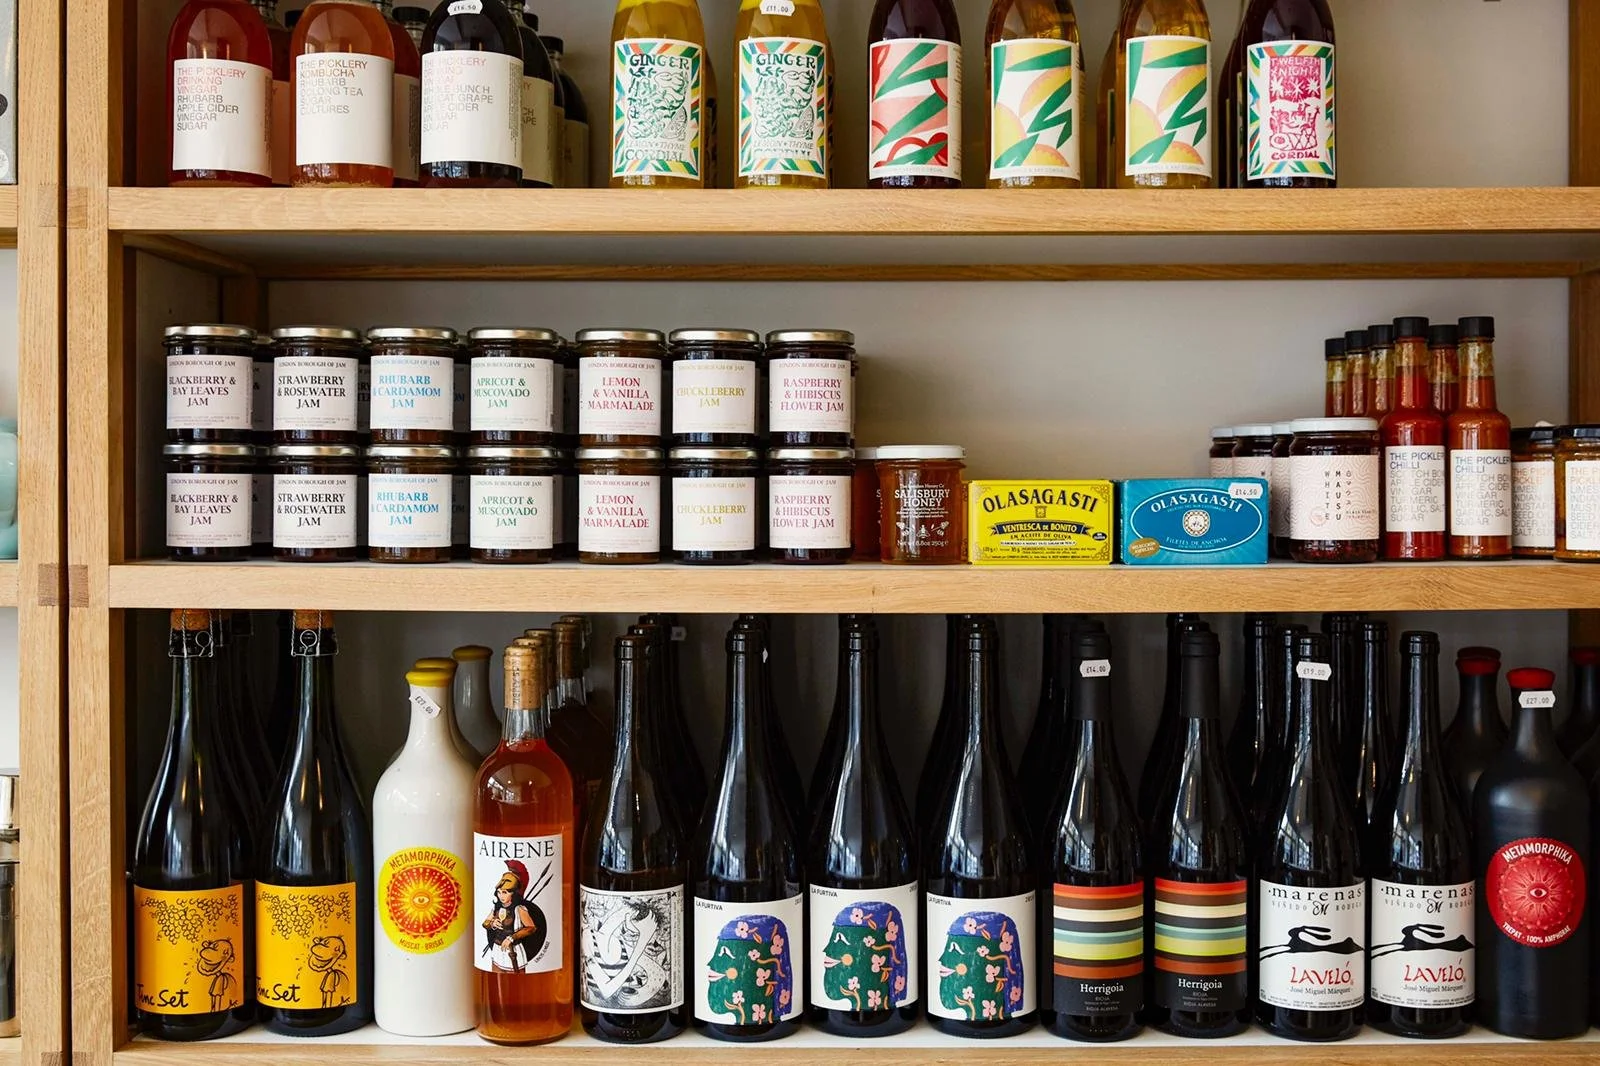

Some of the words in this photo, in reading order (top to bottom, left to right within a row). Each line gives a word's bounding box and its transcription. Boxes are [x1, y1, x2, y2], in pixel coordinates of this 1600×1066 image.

[300, 60, 317, 69] THE
[319, 60, 367, 69] PICKLERY
[629, 54, 689, 70] GINGER
[757, 54, 816, 69] GINGER
[1271, 57, 1320, 65] TWELFTH
[177, 67, 194, 76] THE
[197, 67, 246, 78] PICKLERY
[300, 69, 355, 78] KOMBUCHA
[177, 77, 222, 85] DRINKING
[177, 86, 217, 94] VINEGAR
[343, 87, 363, 96] TEA
[177, 95, 223, 103] RHUBARB
[458, 94, 493, 104] GRAPE
[177, 104, 204, 112] APPLE
[207, 104, 239, 114] CIDER
[177, 113, 217, 121] VINEGAR
[177, 122, 207, 131] SUGAR
[1271, 150, 1320, 160] CORDIAL
[169, 376, 227, 385] BLACKBERRY
[229, 377, 236, 385] &
[278, 375, 345, 385] STRAWBERRY
[379, 375, 431, 385] RHUBARB
[477, 377, 516, 386] APRICOT
[518, 378, 526, 386] &
[602, 377, 641, 387] LEMON
[783, 378, 842, 388] RASPBERRY
[173, 387, 187, 395] BAY
[191, 387, 229, 395] LEAVES
[277, 388, 282, 396] &
[284, 387, 346, 397] ROSEWATER
[378, 387, 441, 397] CARDAMOM
[474, 388, 530, 398] MUSCOVADO
[592, 389, 600, 398] &
[603, 389, 649, 399] VANILLA
[784, 391, 791, 399] &
[795, 390, 841, 400] HIBISCUS
[187, 398, 208, 407] JAM
[296, 399, 320, 409] JAM
[392, 399, 414, 408] JAM
[488, 399, 508, 408] JAM
[588, 401, 654, 411] MARMALADE
[699, 398, 720, 408] JAM
[780, 402, 823, 411] FLOWER
[825, 402, 844, 412] JAM
[1390, 452, 1407, 460] THE
[1390, 461, 1420, 469] CHILLI
[1455, 465, 1484, 473] CHILLI
[278, 493, 345, 502] STRAWBERRY
[377, 492, 429, 501] RHUBARB
[895, 489, 950, 498] SALISBURY
[231, 495, 238, 503] &
[481, 496, 525, 505] APRICOT
[526, 496, 535, 505] &
[595, 495, 634, 505] LEMON
[774, 495, 832, 505] RASPBERRY
[904, 498, 942, 507] HONEY
[982, 488, 1098, 513] OLASAGASTI
[1150, 493, 1244, 513] OLASAGASTI
[175, 505, 190, 514] BAY
[194, 505, 232, 514] LEAVES
[277, 505, 282, 514] &
[284, 505, 346, 514] ROSEWATER
[377, 504, 439, 513] CARDAMOM
[478, 506, 538, 516] MUSCOVADO
[587, 506, 594, 515] &
[597, 506, 644, 517] VANILLA
[775, 507, 781, 516] &
[783, 507, 831, 516] HIBISCUS
[190, 516, 211, 525] JAM
[297, 517, 321, 527] JAM
[389, 515, 412, 525] JAM
[496, 518, 517, 528] JAM
[583, 518, 650, 528] MARMALADE
[700, 516, 722, 526] JAM
[772, 518, 809, 528] FLOWER
[811, 518, 835, 529] JAM
[1002, 523, 1041, 533] VENTRESCA
[1050, 523, 1077, 532] BONITO
[479, 840, 555, 859] AIRENE
[1502, 843, 1573, 865] METAMORPHIKA
[388, 850, 457, 872] METAMORPHIKA
[816, 888, 838, 898] FURTIVA
[1272, 887, 1361, 900] marenas
[1385, 885, 1473, 899] marenas
[702, 902, 723, 911] FURTIVA
[933, 897, 952, 906] FURTIVA
[1502, 921, 1522, 939] TREPAT
[1526, 935, 1543, 943] 100%
[1545, 925, 1571, 943] AMPHORAE
[399, 938, 420, 951] MUSCAT
[424, 938, 444, 950] BRISAT
[1291, 961, 1352, 985] LAVELÓ
[1404, 958, 1464, 982] LAVELÓ
[1080, 982, 1124, 995] Herrigoia
[1178, 978, 1222, 991] Herrigoia
[272, 984, 301, 1003] Set
[1305, 987, 1326, 995] Miguel
[157, 989, 189, 1008] Set
